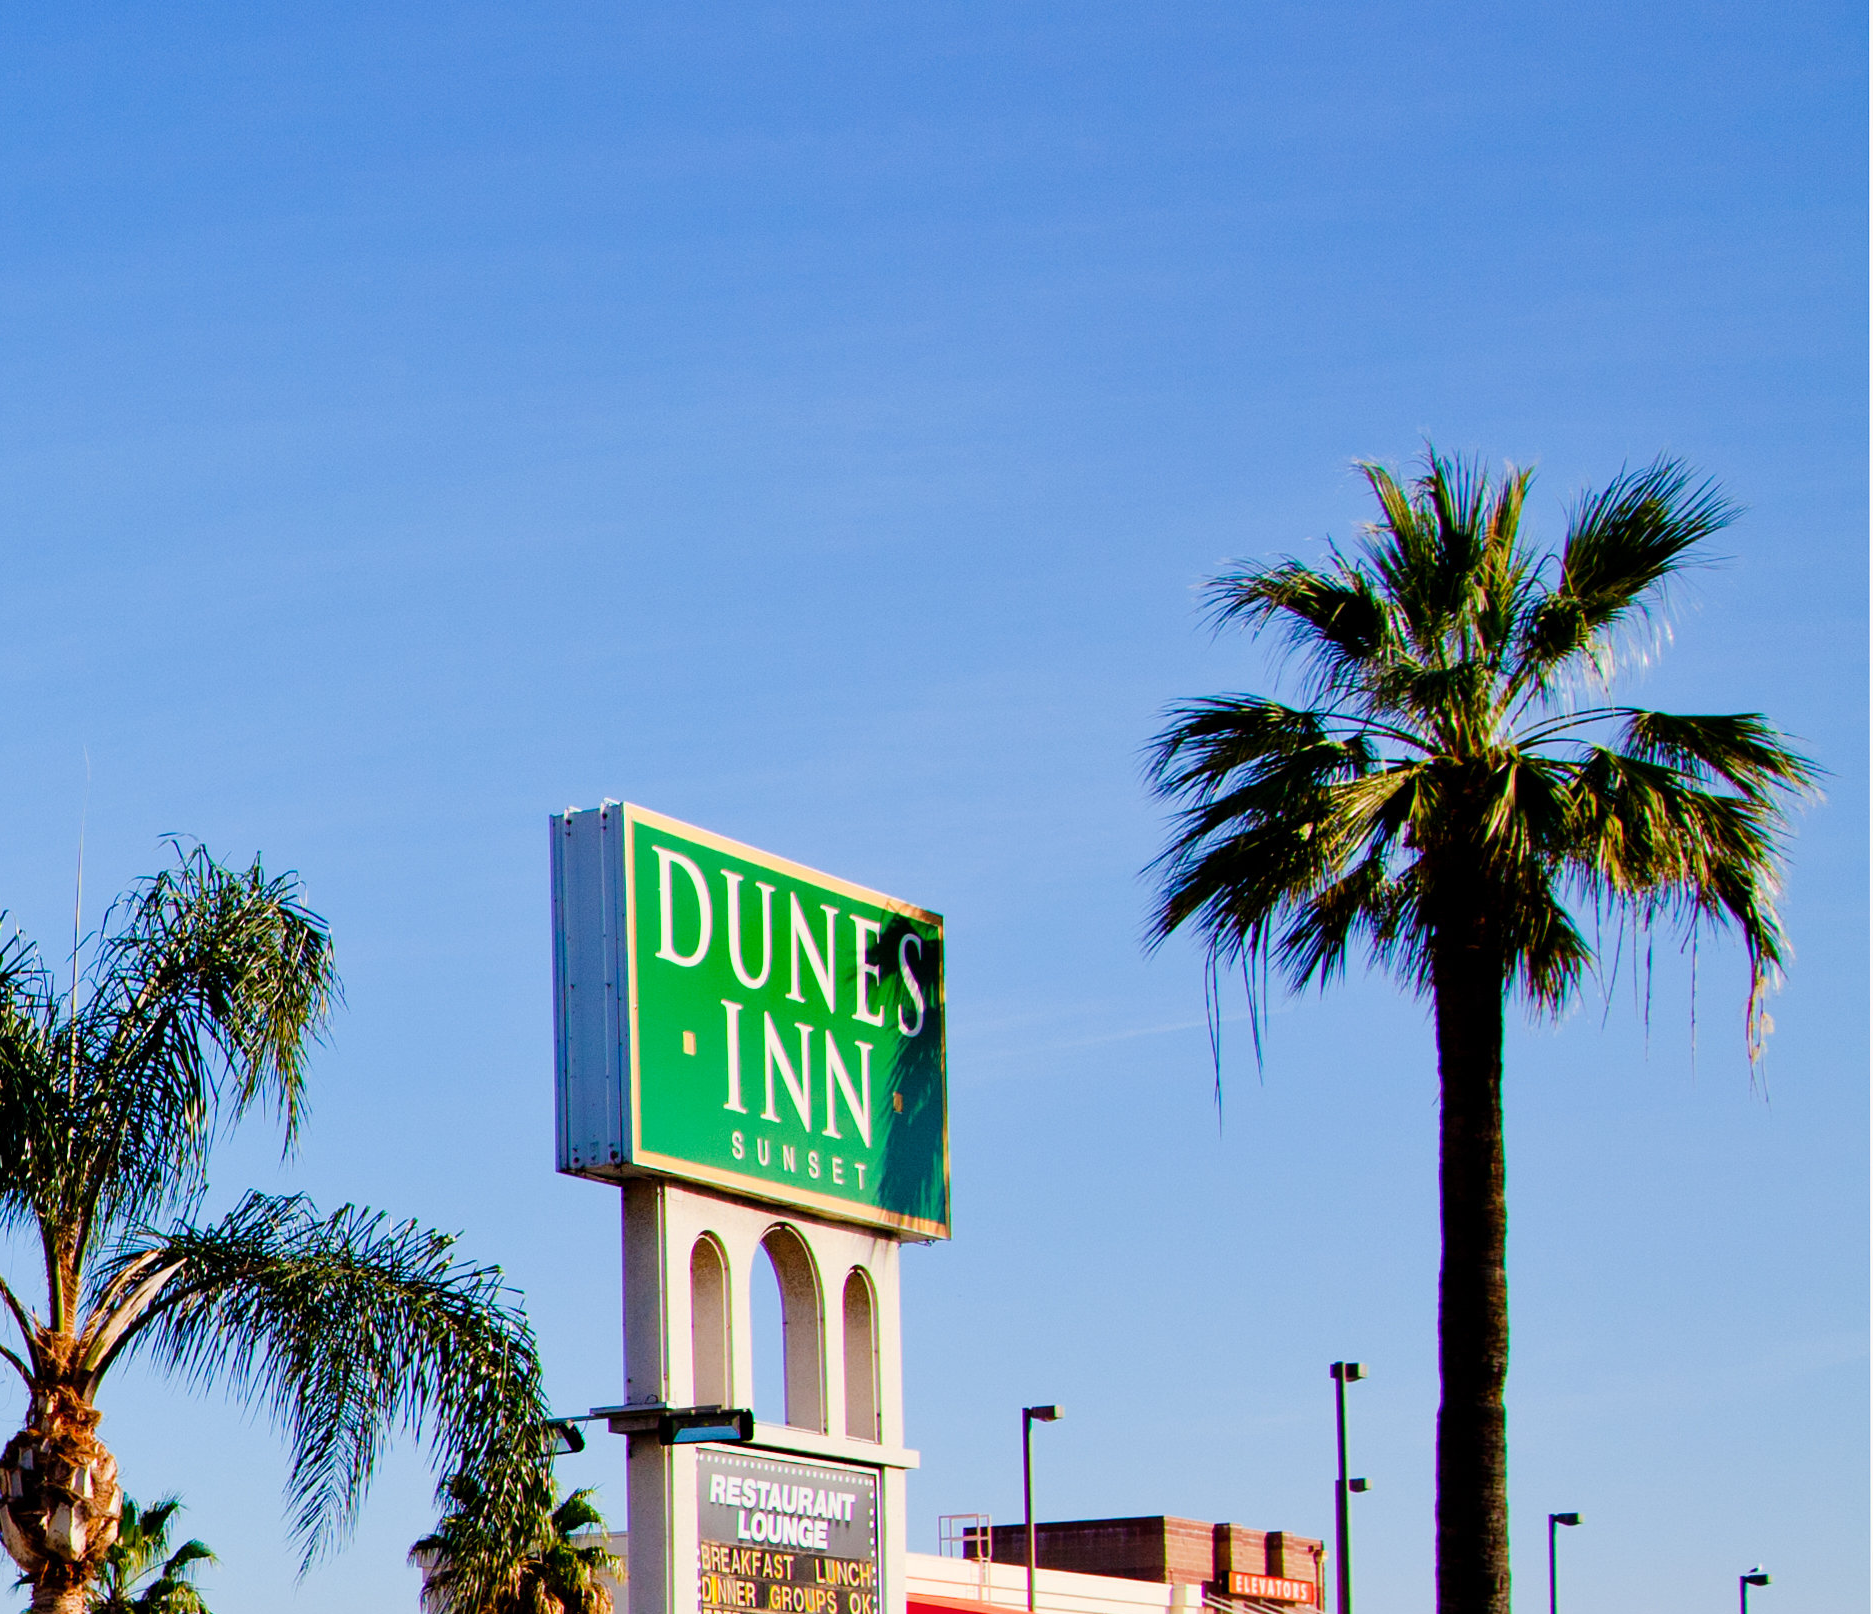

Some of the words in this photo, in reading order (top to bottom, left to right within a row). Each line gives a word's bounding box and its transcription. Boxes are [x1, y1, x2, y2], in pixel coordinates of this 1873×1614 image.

[651, 845, 926, 1038] DUNES
[720, 999, 874, 1149] INN
[731, 1130, 867, 1191] SUNSET
[709, 1473, 856, 1522] RESTAURANT
[737, 1510, 829, 1550] LOUNGE
[700, 1544, 794, 1581] BREAKFAST
[814, 1558, 873, 1588] LUNCH
[1235, 1574, 1308, 1601] ELEVATORS
[700, 1575, 757, 1608] DINNER
